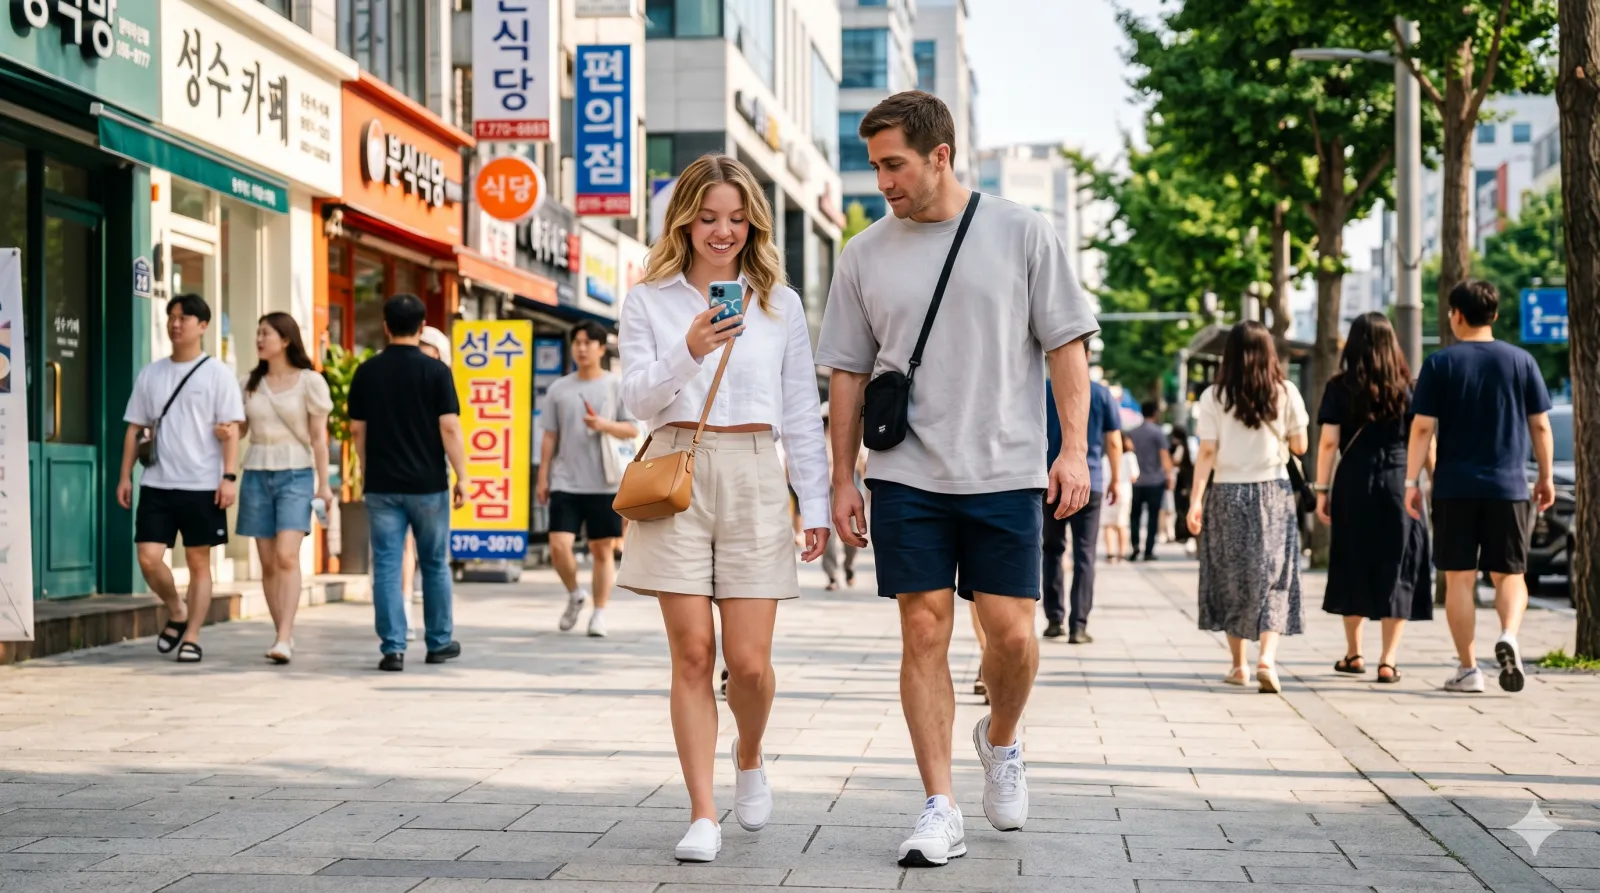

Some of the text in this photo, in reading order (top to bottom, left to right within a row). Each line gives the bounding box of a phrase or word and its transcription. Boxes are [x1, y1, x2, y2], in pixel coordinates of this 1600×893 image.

[177, 27, 232, 119] 성수
[242, 60, 289, 147] 카페
[492, 0, 534, 112] 식당
[583, 50, 624, 186] 편의점
[386, 133, 445, 208] 분식식당
[482, 174, 536, 204] 식당
[459, 331, 524, 368] 성수
[469, 378, 513, 521] 편의점
[451, 535, 524, 552] 370-3070
